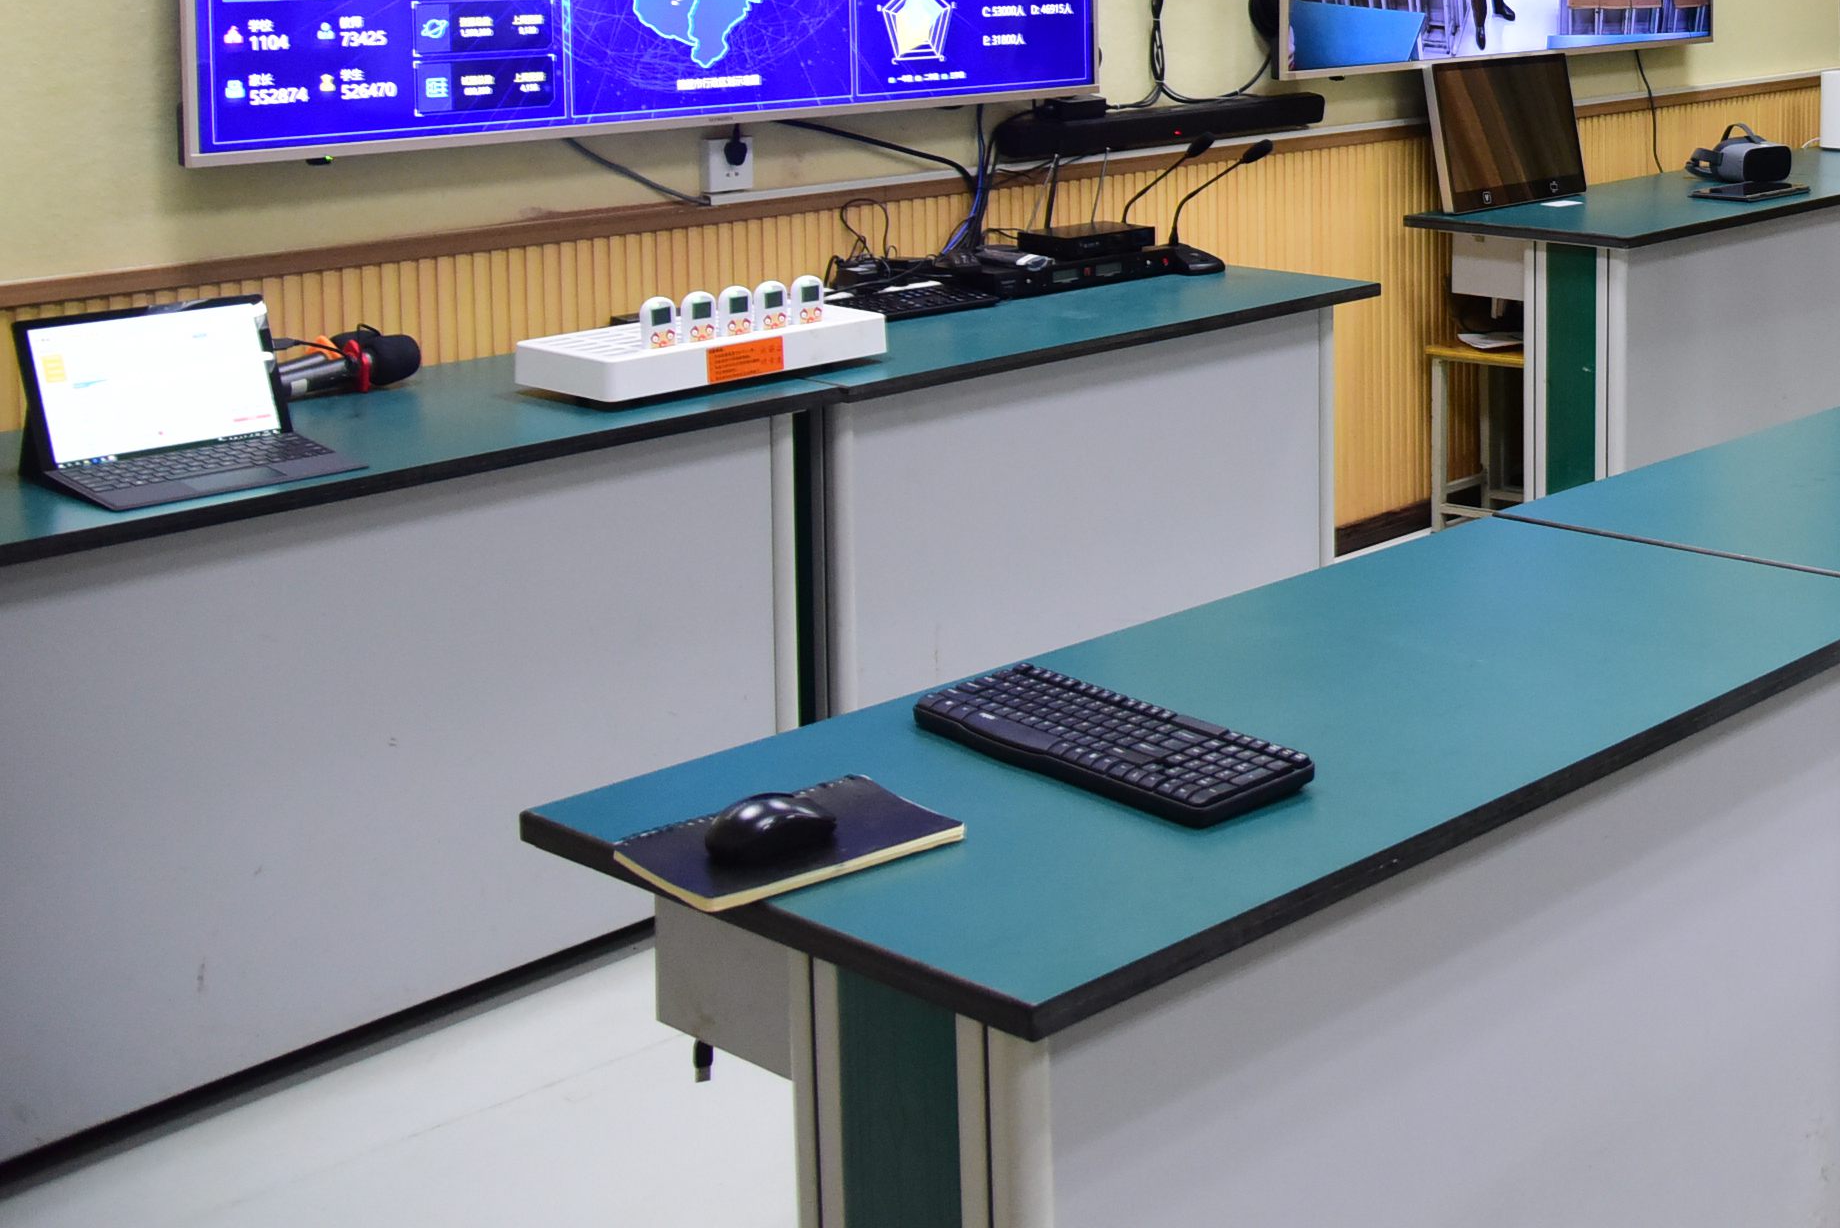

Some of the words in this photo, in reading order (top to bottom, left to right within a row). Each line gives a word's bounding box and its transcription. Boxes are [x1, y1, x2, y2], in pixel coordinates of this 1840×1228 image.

[249, 35, 290, 50] 1104
[340, 30, 387, 46] 73425
[249, 87, 309, 105] 552874
[341, 82, 397, 99] 526470
